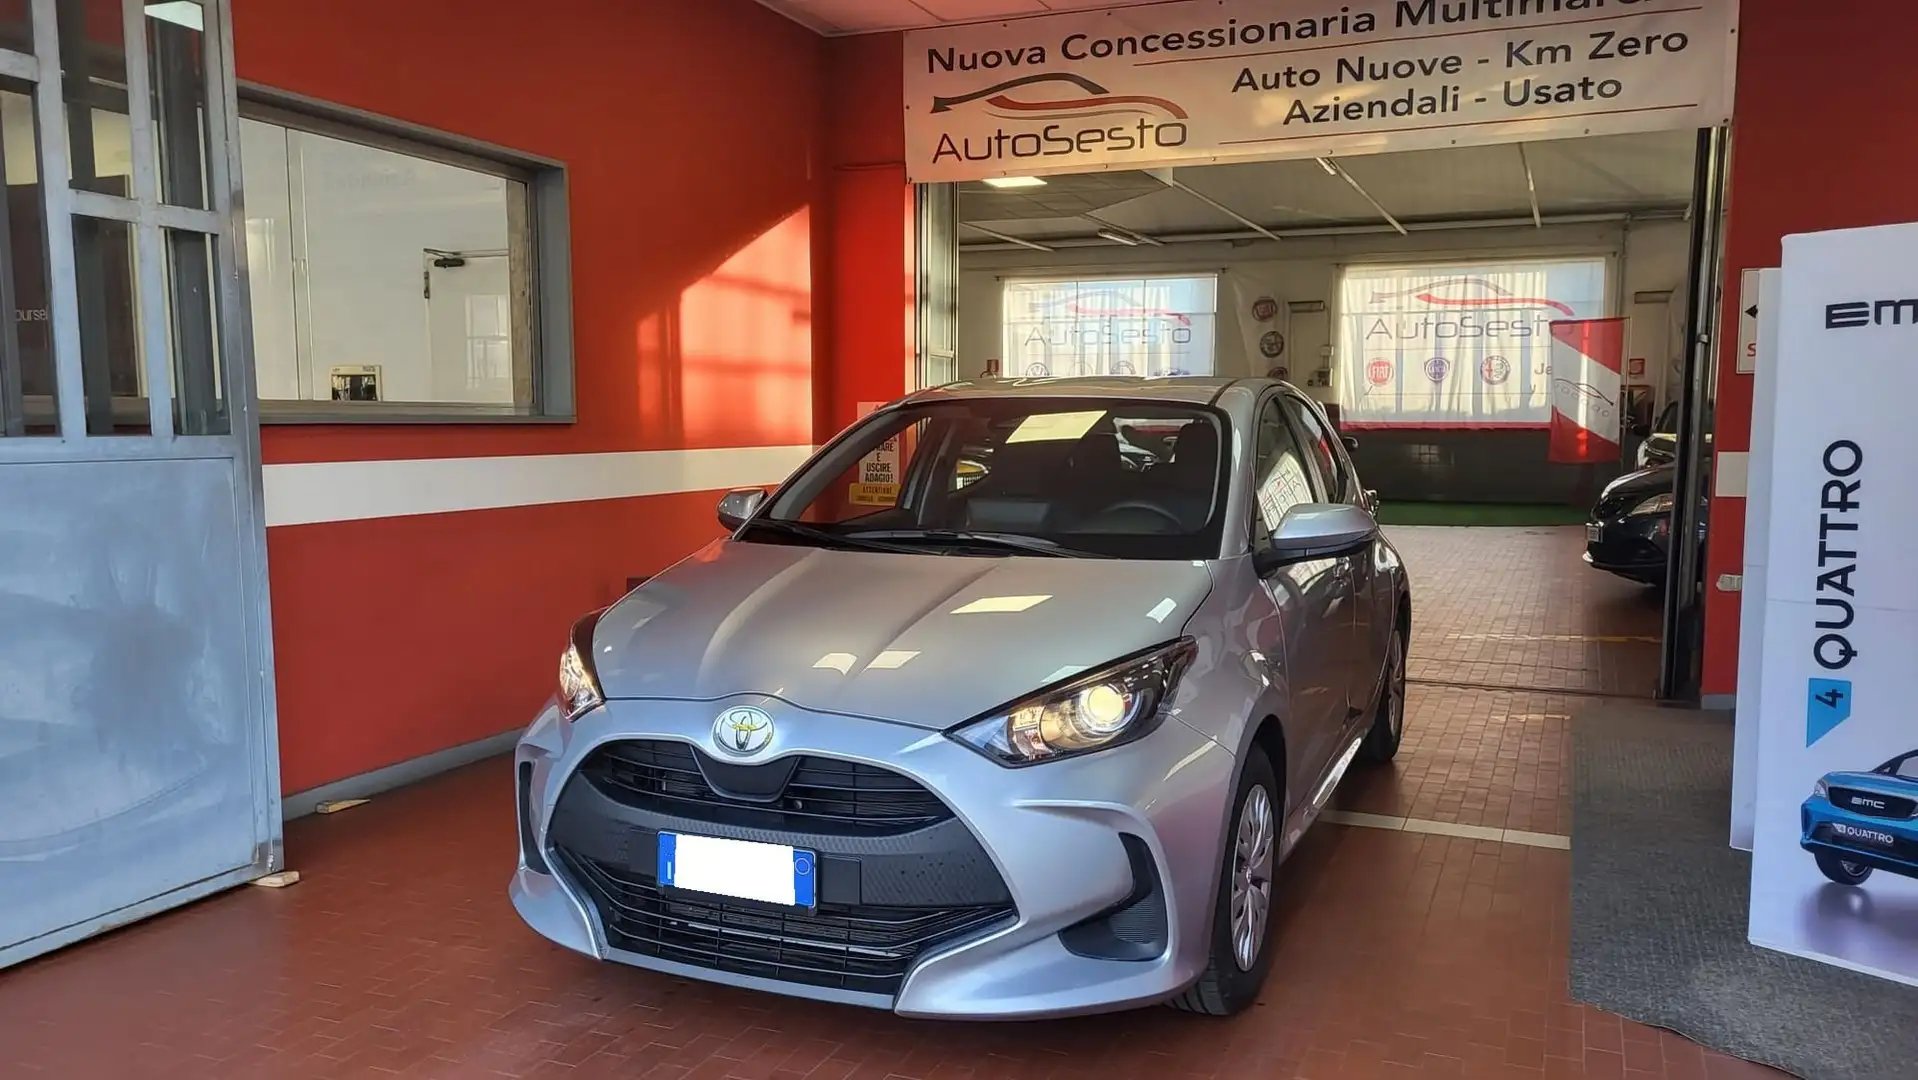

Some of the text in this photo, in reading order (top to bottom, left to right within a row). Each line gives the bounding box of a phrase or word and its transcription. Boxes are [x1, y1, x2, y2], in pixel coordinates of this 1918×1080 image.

[927, 44, 1047, 74] Nuova
[1061, 7, 1376, 60] Concessionaria
[1232, 66, 1321, 93] Auto
[1336, 49, 1462, 84] Nuove
[1506, 39, 1572, 68] Km
[1588, 30, 1689, 60] Zero
[1283, 85, 1461, 126] Aziendali
[1503, 76, 1623, 107] Usato
[932, 117, 1188, 164] AutoSesto
[1025, 318, 1191, 347] AutoSesto
[866, 462, 892, 473] USCIRE
[1813, 439, 1864, 709] 4 QUATTRO
[1847, 826, 1894, 845] QUATTRO
